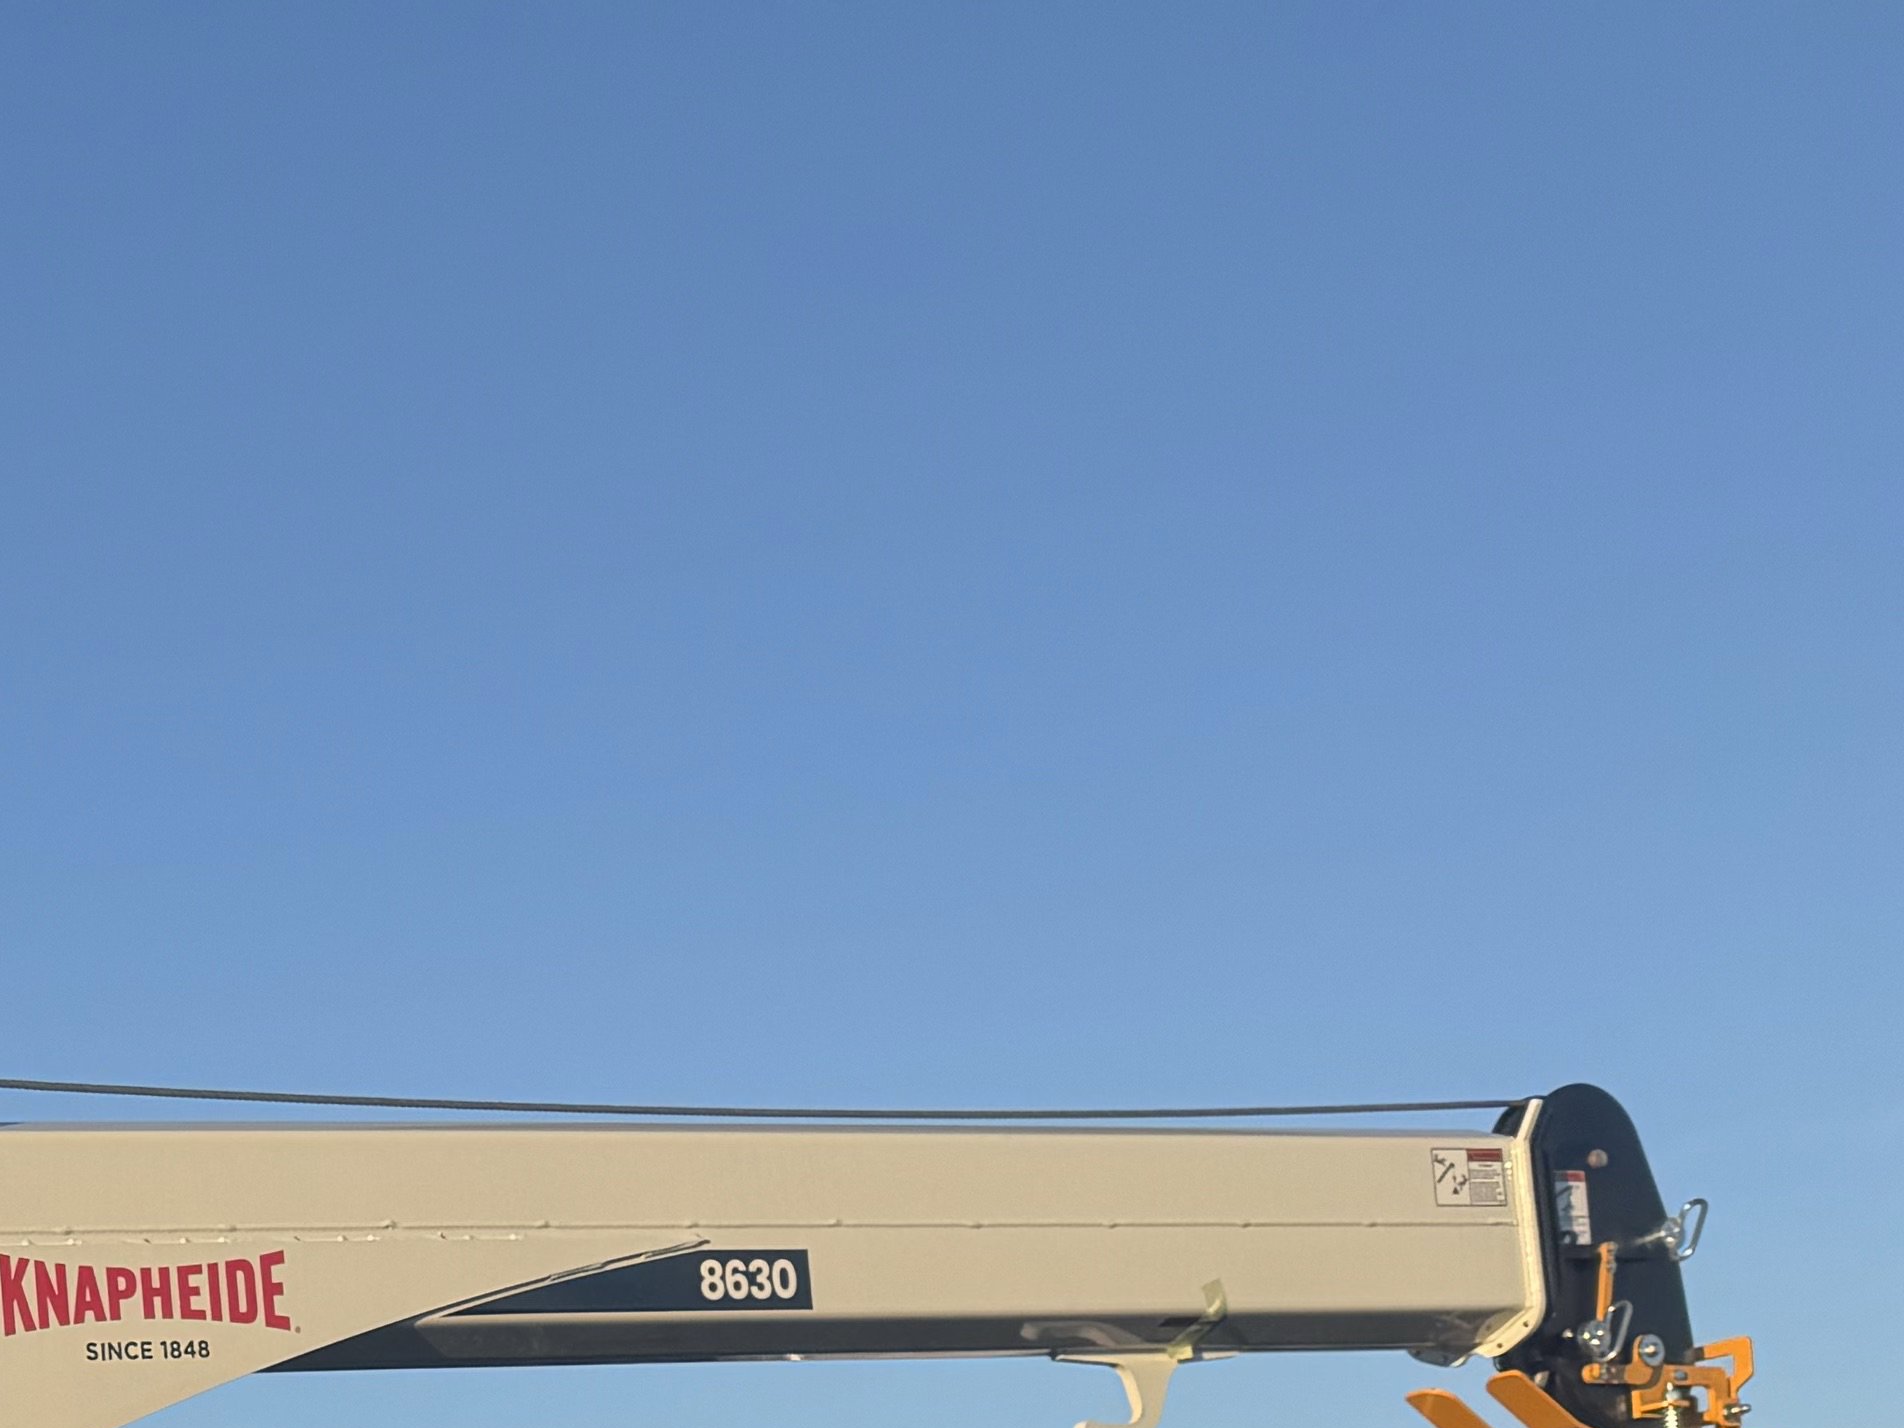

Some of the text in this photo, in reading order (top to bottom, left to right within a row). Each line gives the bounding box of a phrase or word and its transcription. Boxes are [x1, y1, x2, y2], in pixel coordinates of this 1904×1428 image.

[699, 1257, 798, 1302] 8630
[85, 1338, 211, 1362] SINCE 1848
